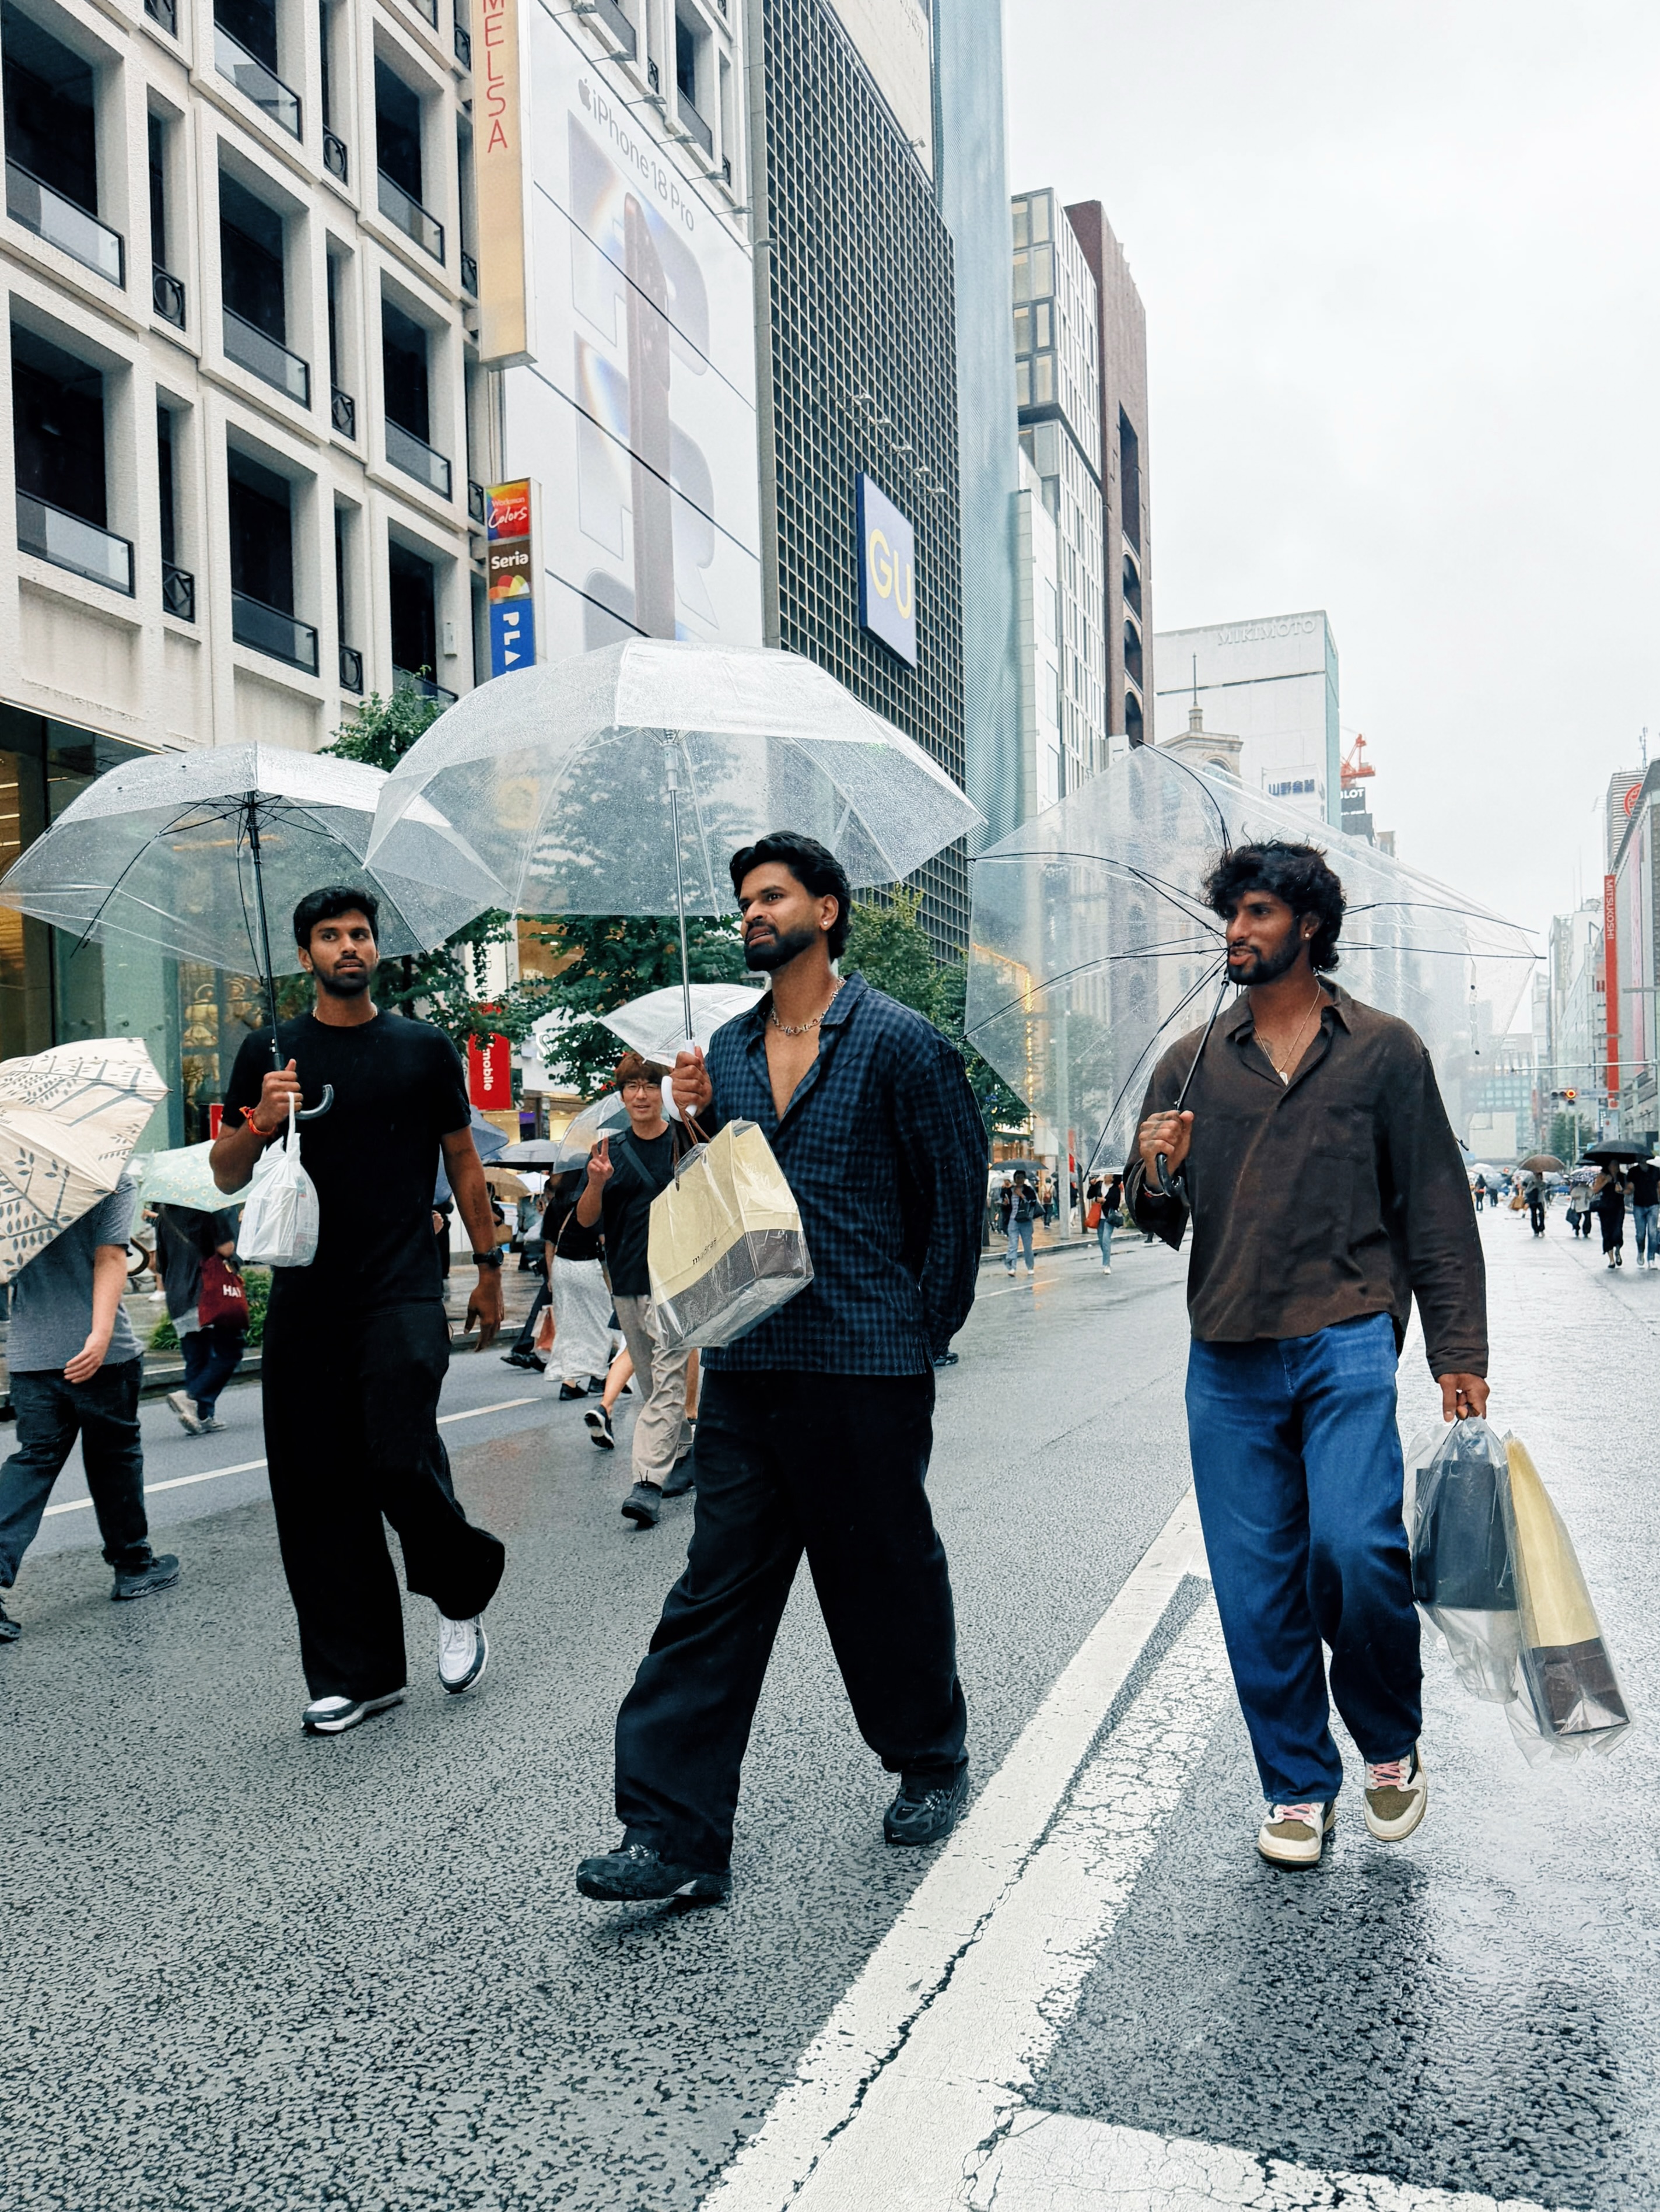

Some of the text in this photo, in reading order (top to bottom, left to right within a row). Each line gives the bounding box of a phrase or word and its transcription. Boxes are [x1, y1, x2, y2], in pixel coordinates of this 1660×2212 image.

[593, 89, 694, 232] iPhone 18 Pro
[488, 506, 527, 528] Colors
[492, 497, 525, 507] Workman
[491, 551, 528, 570] Seria
[868, 528, 911, 619] GU
[503, 611, 521, 673] PLA
[1217, 620, 1316, 646] MIKIMOTO
[1606, 879, 1615, 940] MITSUKOSHI
